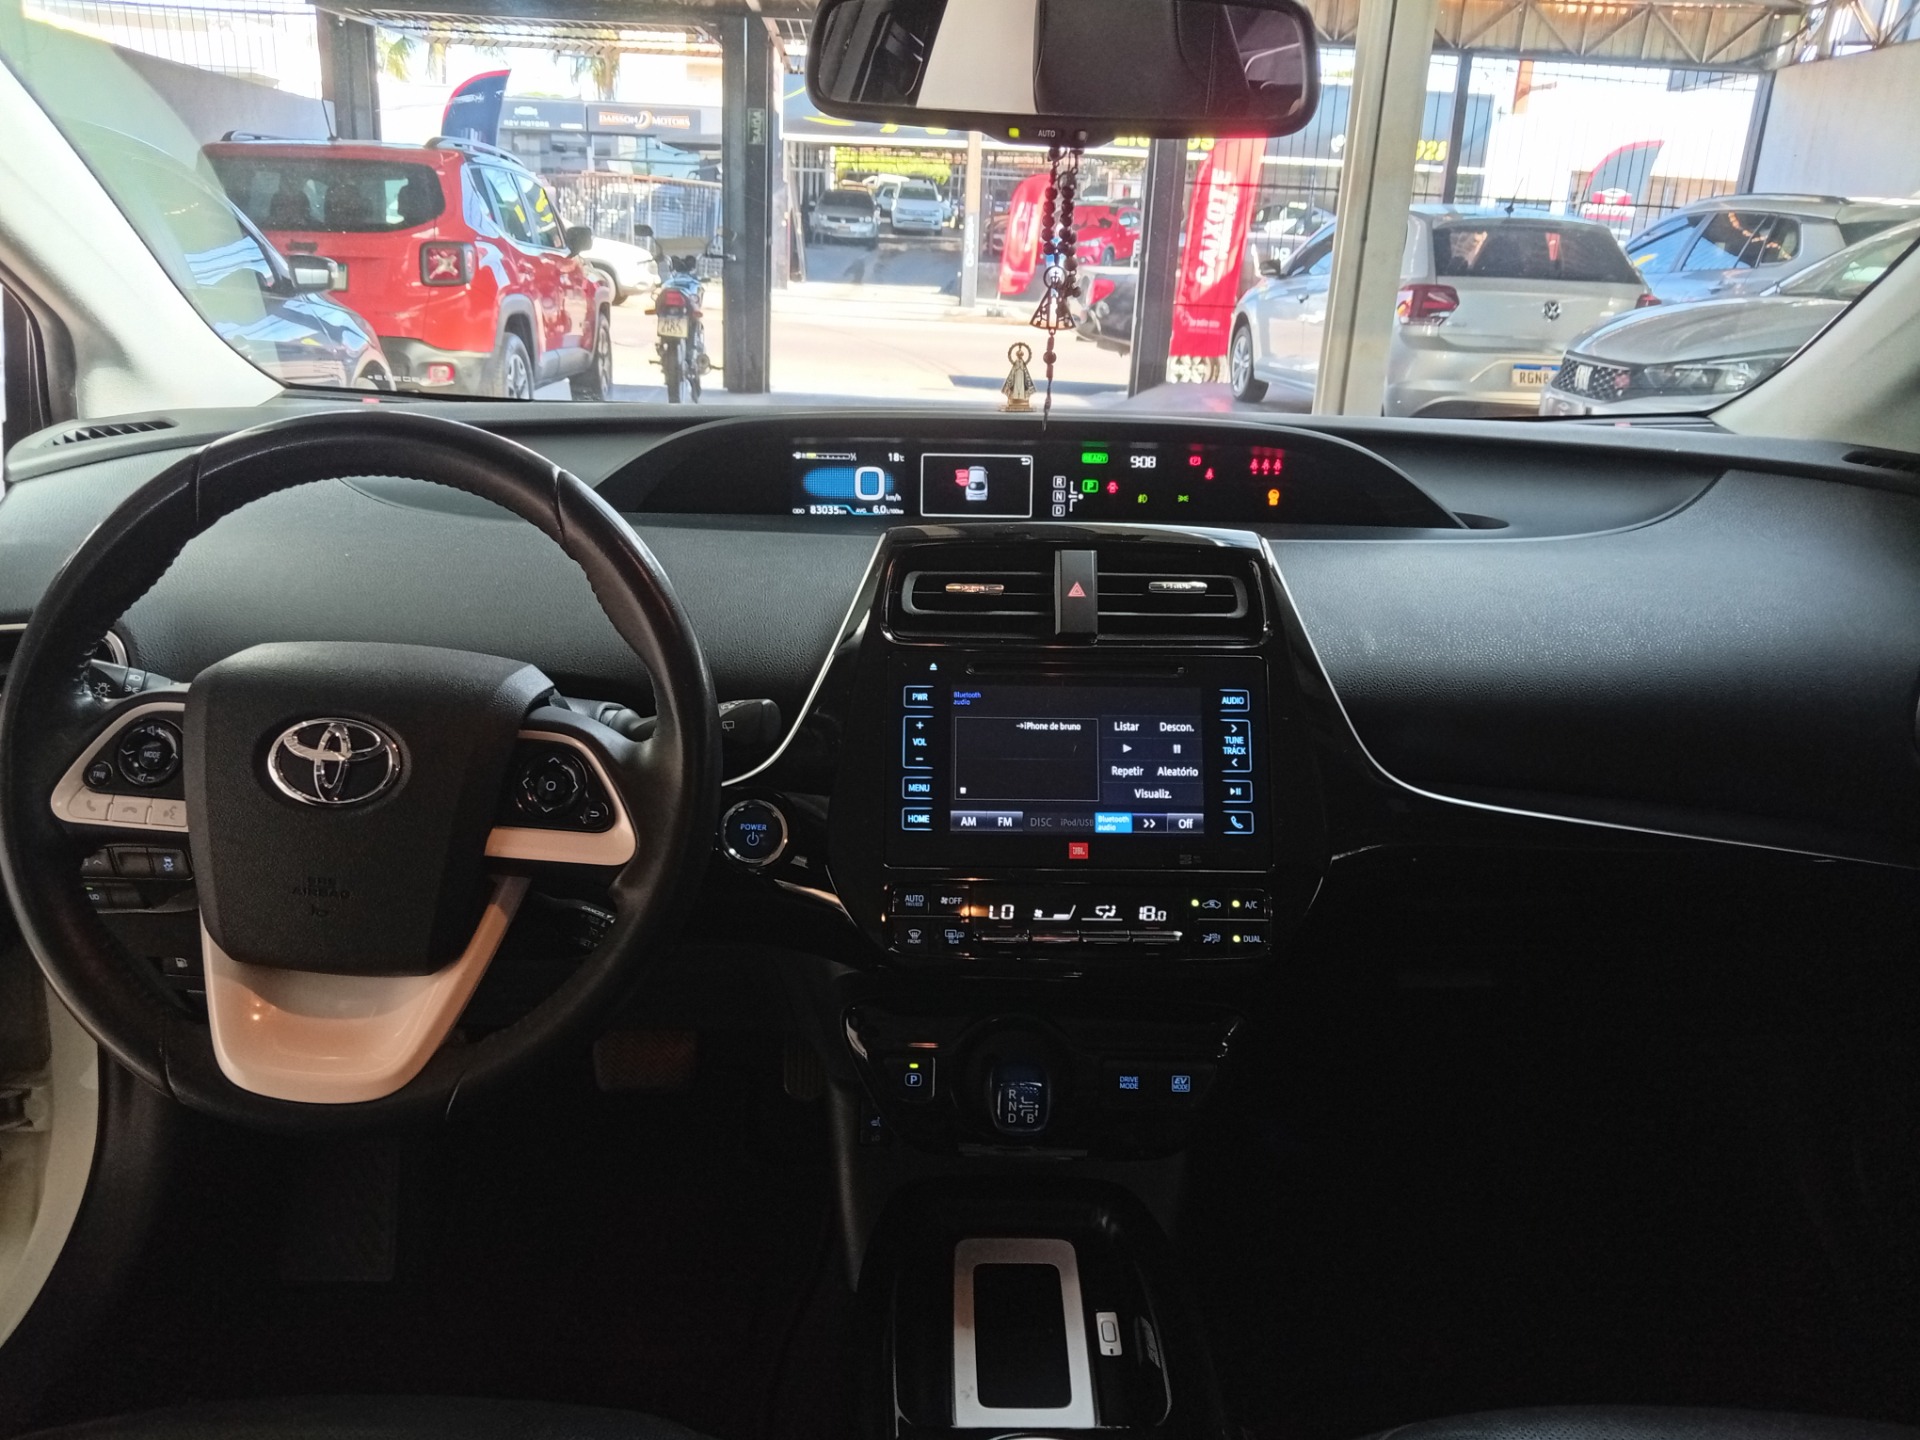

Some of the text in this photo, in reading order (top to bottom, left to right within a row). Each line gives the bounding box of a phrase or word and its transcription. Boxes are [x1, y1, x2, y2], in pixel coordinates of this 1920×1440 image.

[652, 116, 690, 128] MOTORS
[1038, 129, 1056, 138] AUTO
[1195, 168, 1231, 285] CAIXOTE
[1130, 456, 1157, 469] 9:08
[854, 466, 885, 500] 0
[1056, 477, 1064, 486] R
[885, 494, 902, 502] km/h
[1055, 492, 1063, 501] N
[1054, 506, 1063, 515] D
[912, 692, 929, 701] PWR
[953, 691, 982, 699] Bluetooth
[1221, 696, 1245, 705] AUDIO
[1023, 721, 1082, 731] iPhone de bruno
[1113, 721, 1140, 732] Listar
[1159, 721, 1195, 732] Descon.
[912, 737, 928, 747] VOL
[1224, 736, 1245, 745] TUNE
[143, 750, 161, 760] MODE
[1222, 746, 1247, 756] TRACK
[1111, 765, 1144, 778] Repetir
[1156, 765, 1199, 778] Aleatório
[908, 783, 930, 793] MENU
[1133, 788, 1172, 799] Visualiz.
[907, 814, 930, 824] HOME
[960, 816, 977, 827] AM
[997, 816, 1013, 828] FM
[1030, 817, 1053, 828] DISC
[1097, 815, 1130, 824] Bluetooth
[1178, 818, 1194, 830] Off
[740, 823, 767, 831] POWER
[1097, 824, 1117, 832] audio
[904, 894, 925, 903] AUTO
[948, 896, 963, 905] OFF
[1244, 900, 1258, 910] A/C
[988, 904, 1015, 920] LO
[1138, 905, 1167, 922] 18.0
[1242, 934, 1262, 943] DUAL
[909, 1074, 918, 1085] P
[1119, 1075, 1139, 1083] DRIVE
[1119, 1082, 1139, 1090] MODE
[1008, 1089, 1017, 1100] R
[1008, 1101, 1018, 1112] N
[1007, 1113, 1018, 1124] D
[1026, 1113, 1035, 1124] B
